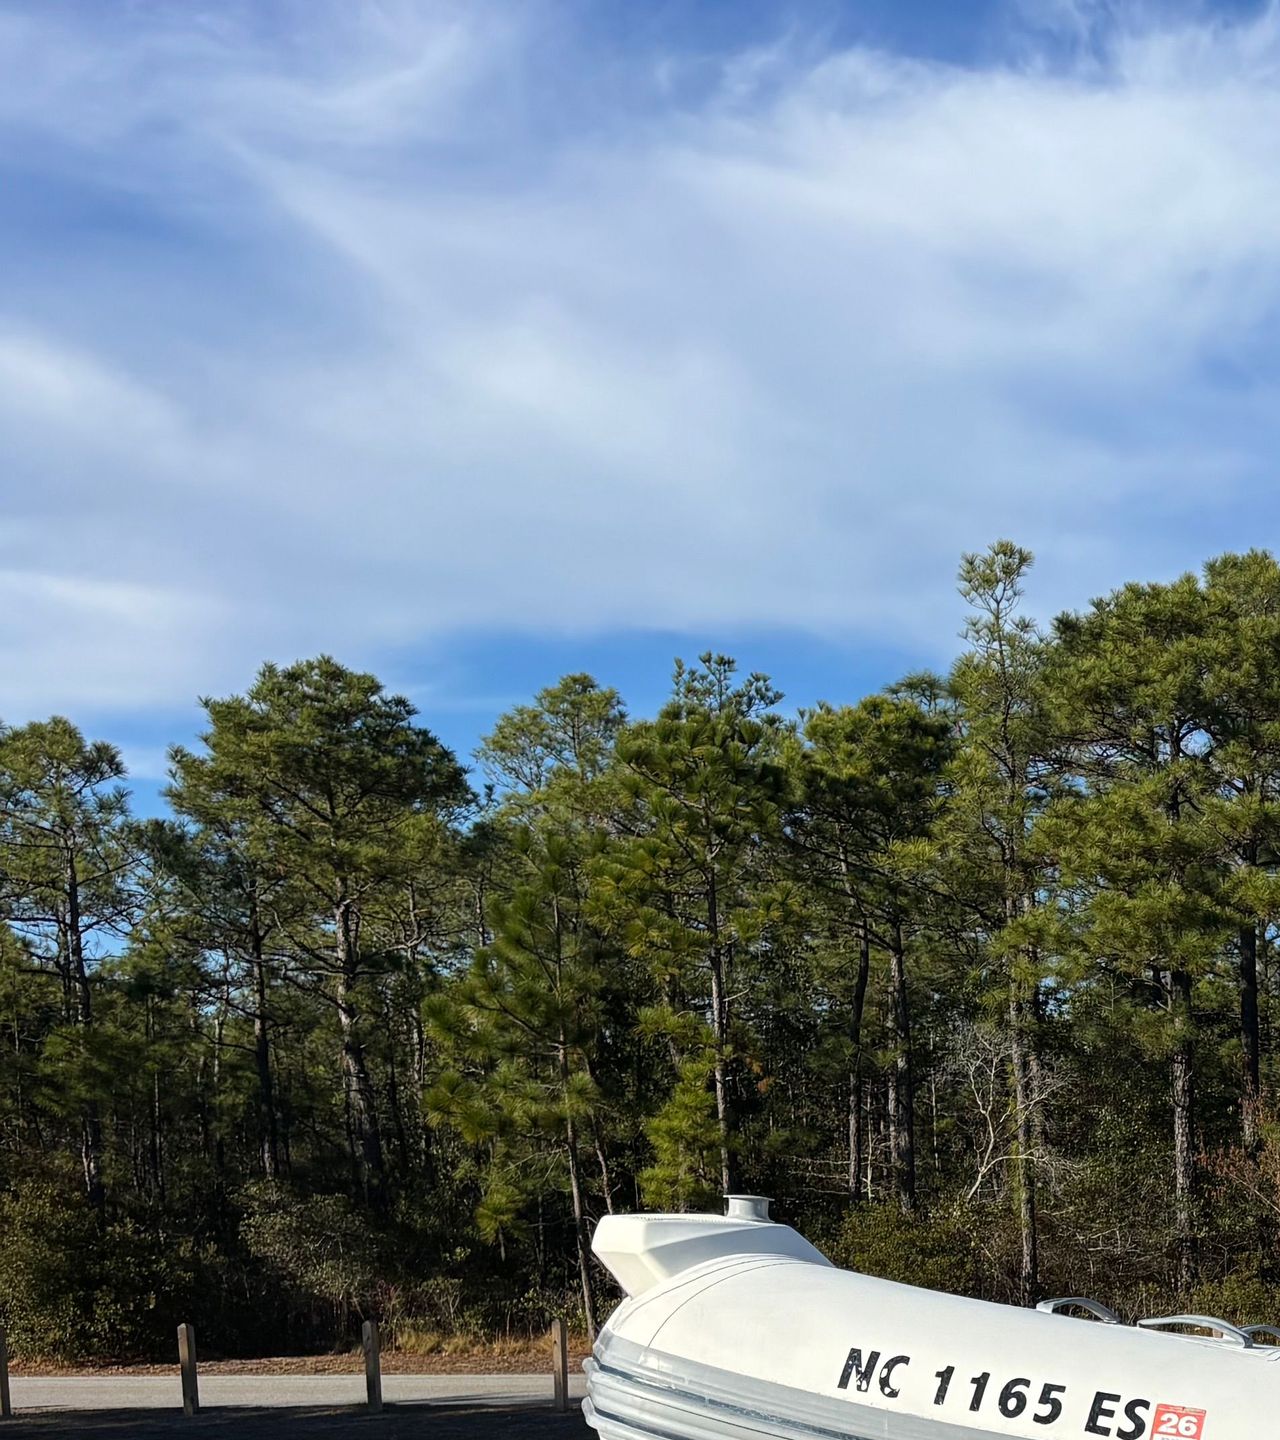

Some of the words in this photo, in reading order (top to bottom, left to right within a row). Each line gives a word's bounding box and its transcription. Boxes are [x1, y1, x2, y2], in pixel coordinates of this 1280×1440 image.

[837, 1348, 910, 1398] NC
[933, 1365, 1066, 1425] 1165
[1084, 1391, 1150, 1440] ES
[1156, 1412, 1199, 1437] 26
